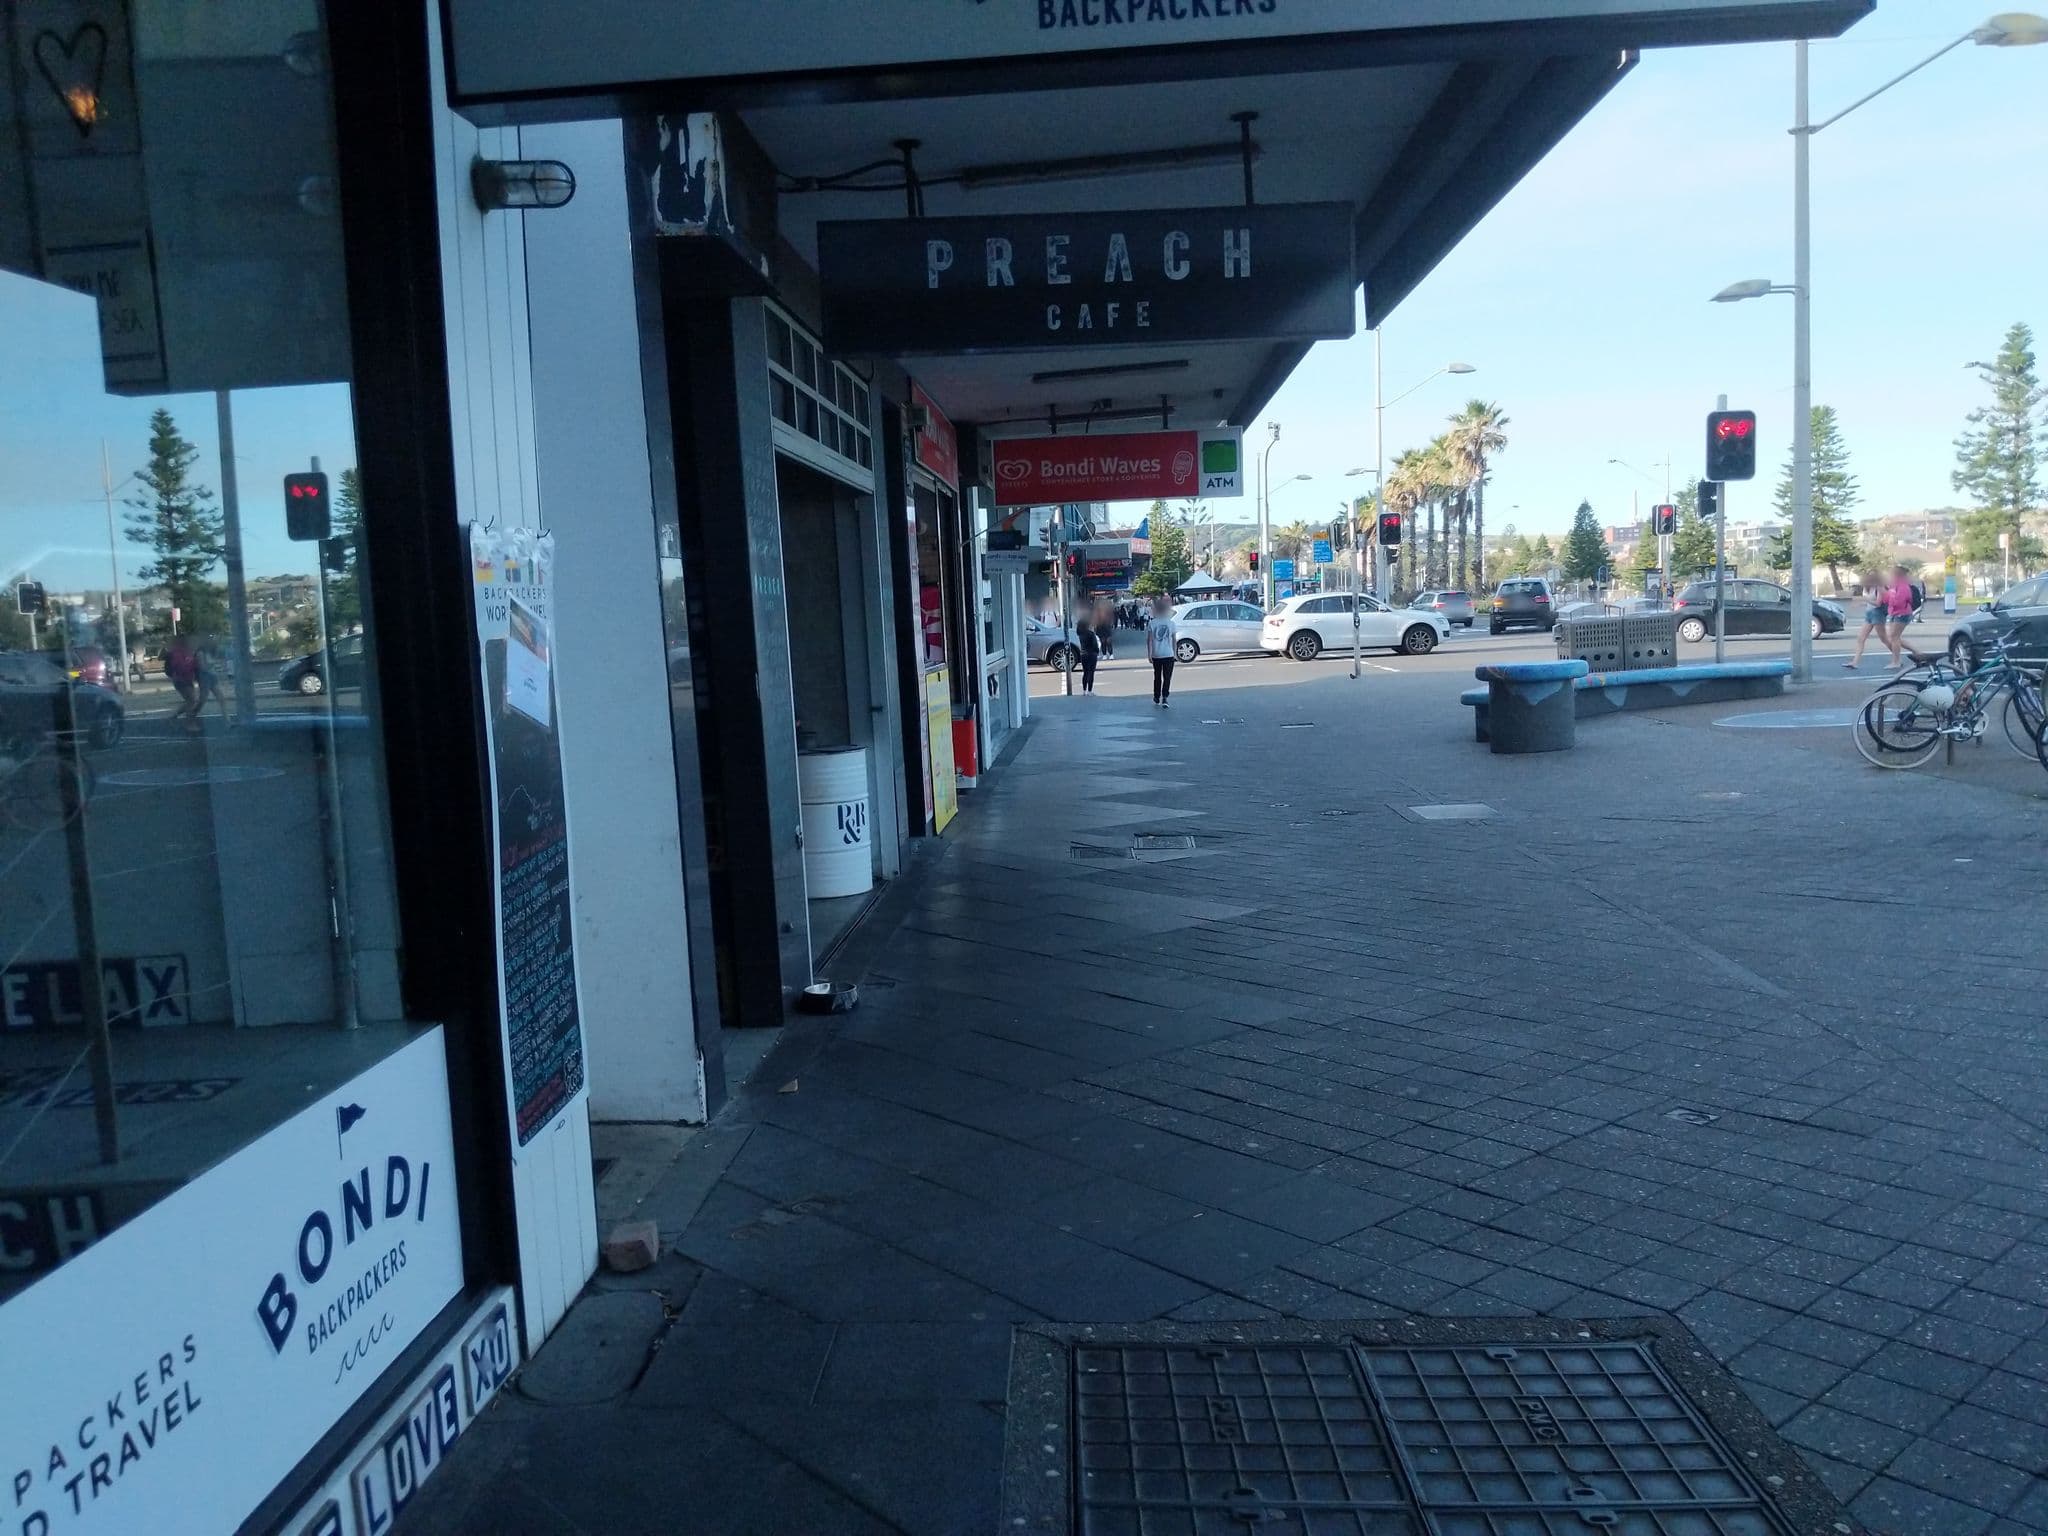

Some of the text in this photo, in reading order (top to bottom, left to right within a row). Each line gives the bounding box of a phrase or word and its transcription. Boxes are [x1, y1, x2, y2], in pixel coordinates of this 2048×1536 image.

[927, 228, 1251, 288] PREACH
[1046, 301, 1150, 330] CAFE
[1041, 456, 1161, 477] Bondi Waves
[1206, 477, 1234, 488] ATM
[257, 1155, 430, 1354] BONDI
[307, 1240, 407, 1355] BACKPACKERS
[64, 1380, 202, 1516] TRAVEL
[363, 1372, 457, 1536] LOVE
